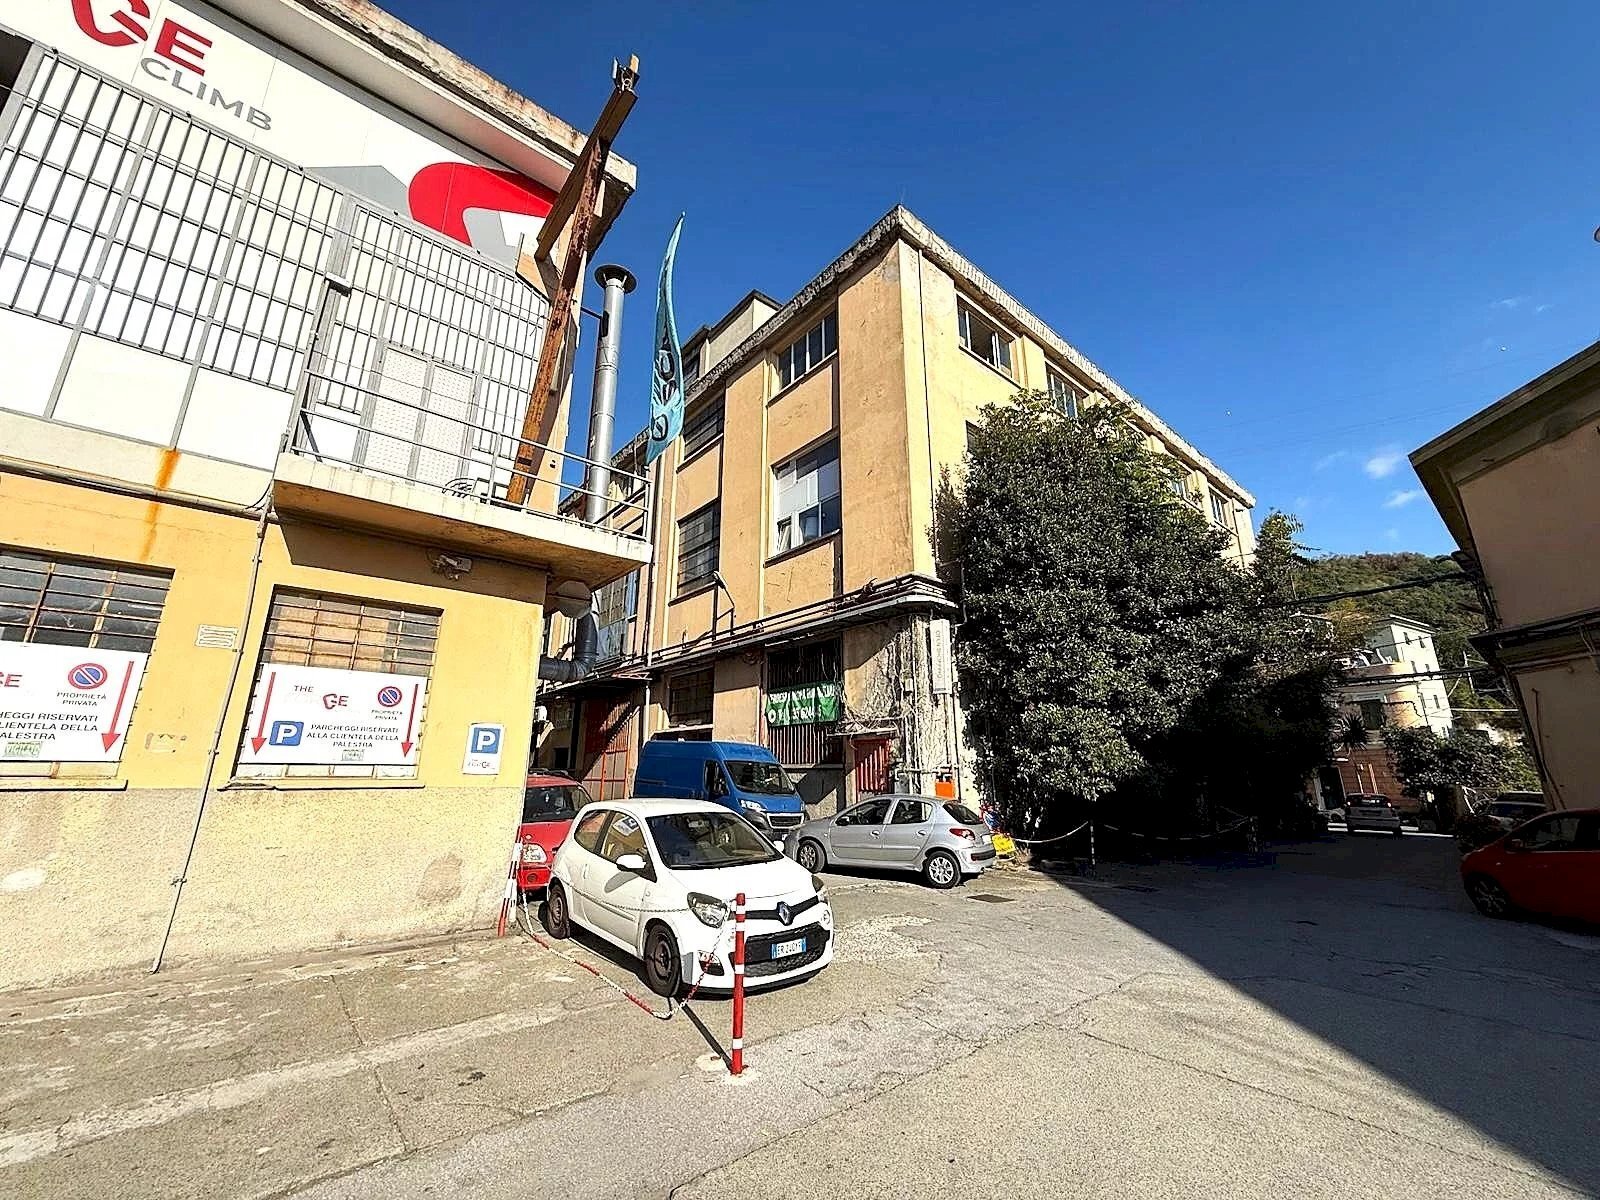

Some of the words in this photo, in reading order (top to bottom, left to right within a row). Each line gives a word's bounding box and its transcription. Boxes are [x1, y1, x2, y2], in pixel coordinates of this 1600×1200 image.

[140, 57, 272, 131] CLIMB
[294, 685, 315, 693] THE
[56, 691, 106, 700] PROPRIETÀ
[62, 699, 98, 707] PRIVATA
[38, 712, 98, 722] RISERVATI
[60, 723, 98, 732] DELLA
[311, 724, 359, 732] PARCHEGGI
[275, 724, 298, 744] P
[330, 732, 373, 741] CLIENTELA
[476, 730, 496, 751] P
